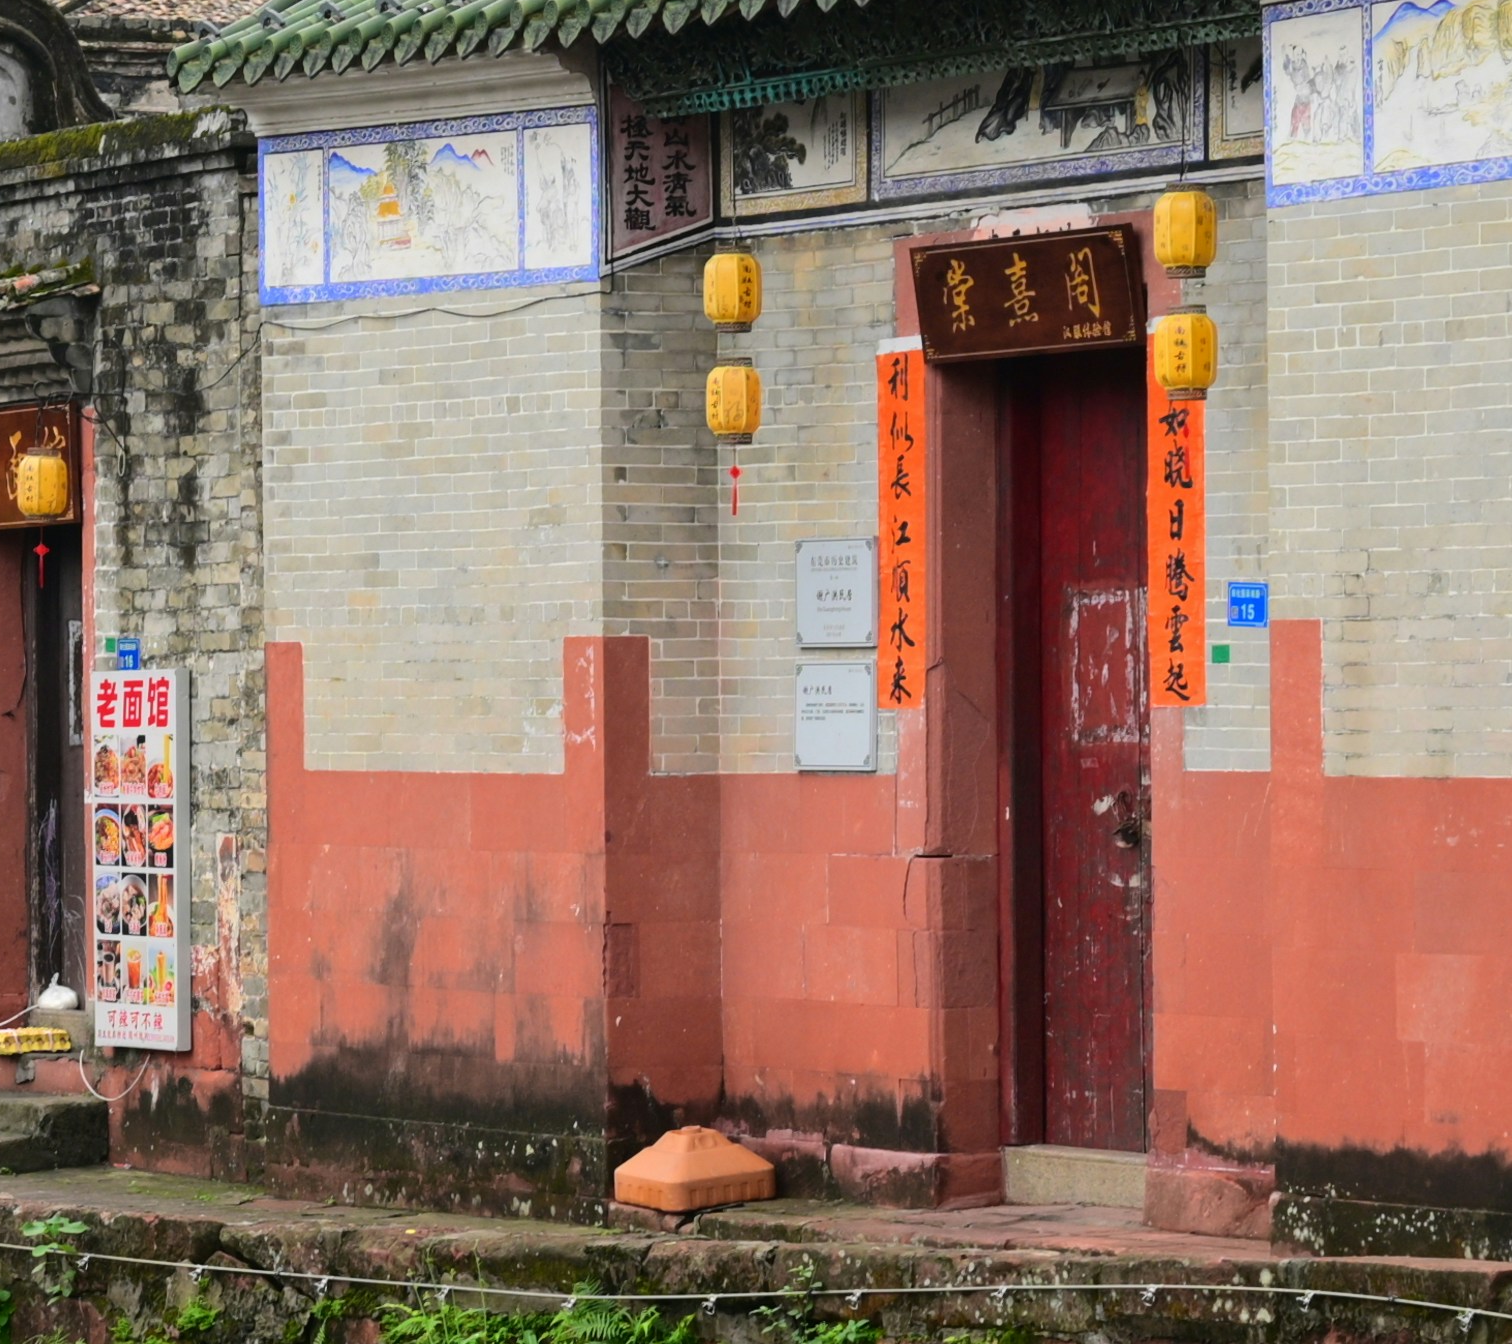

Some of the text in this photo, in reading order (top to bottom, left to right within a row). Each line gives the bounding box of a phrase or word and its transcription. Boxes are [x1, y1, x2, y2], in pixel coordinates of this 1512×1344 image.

[1241, 603, 1255, 620] 15
[96, 676, 170, 728] 老面馆
